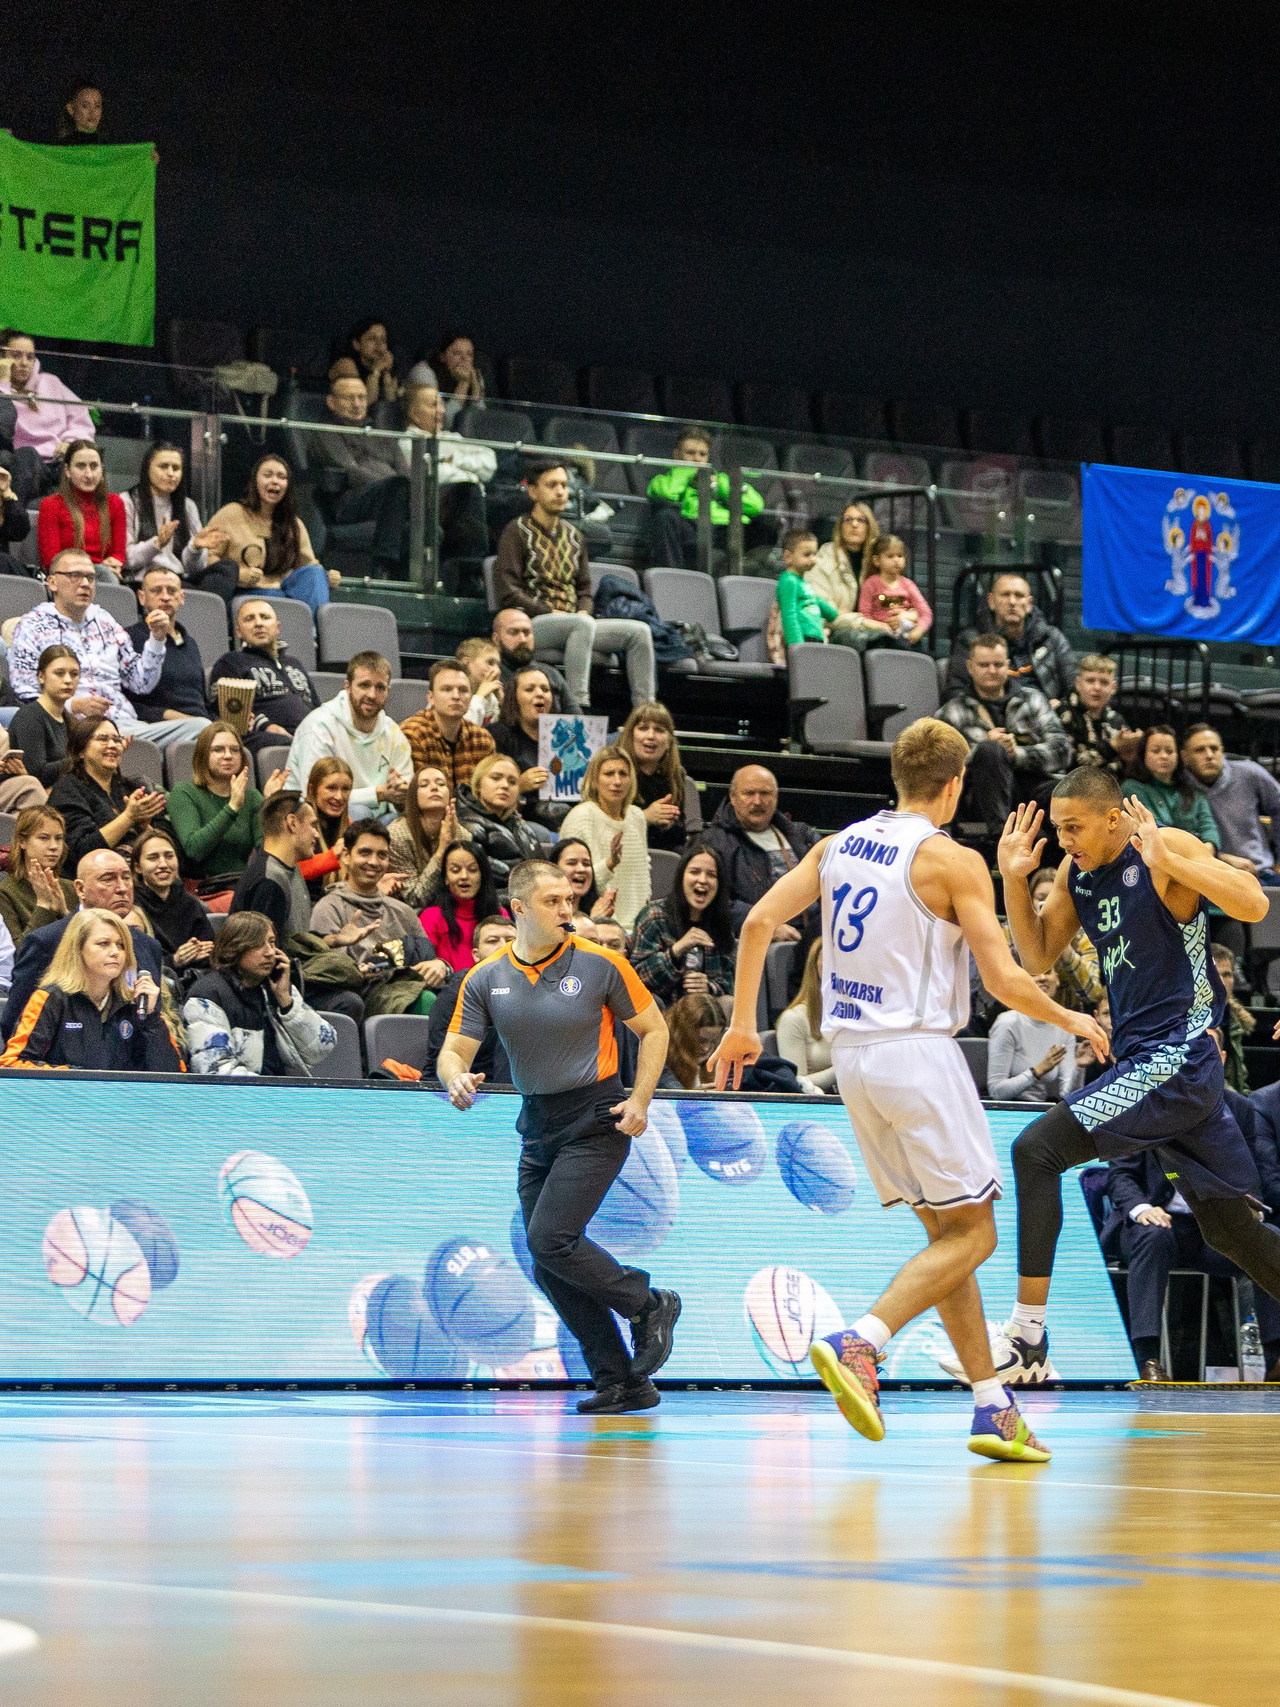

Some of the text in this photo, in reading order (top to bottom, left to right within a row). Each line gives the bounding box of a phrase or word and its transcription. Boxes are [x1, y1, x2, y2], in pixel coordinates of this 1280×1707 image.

[0, 203, 143, 262] T.ERA
[839, 834, 899, 866] SONKO
[831, 882, 878, 952] 13
[1097, 895, 1121, 932] 33
